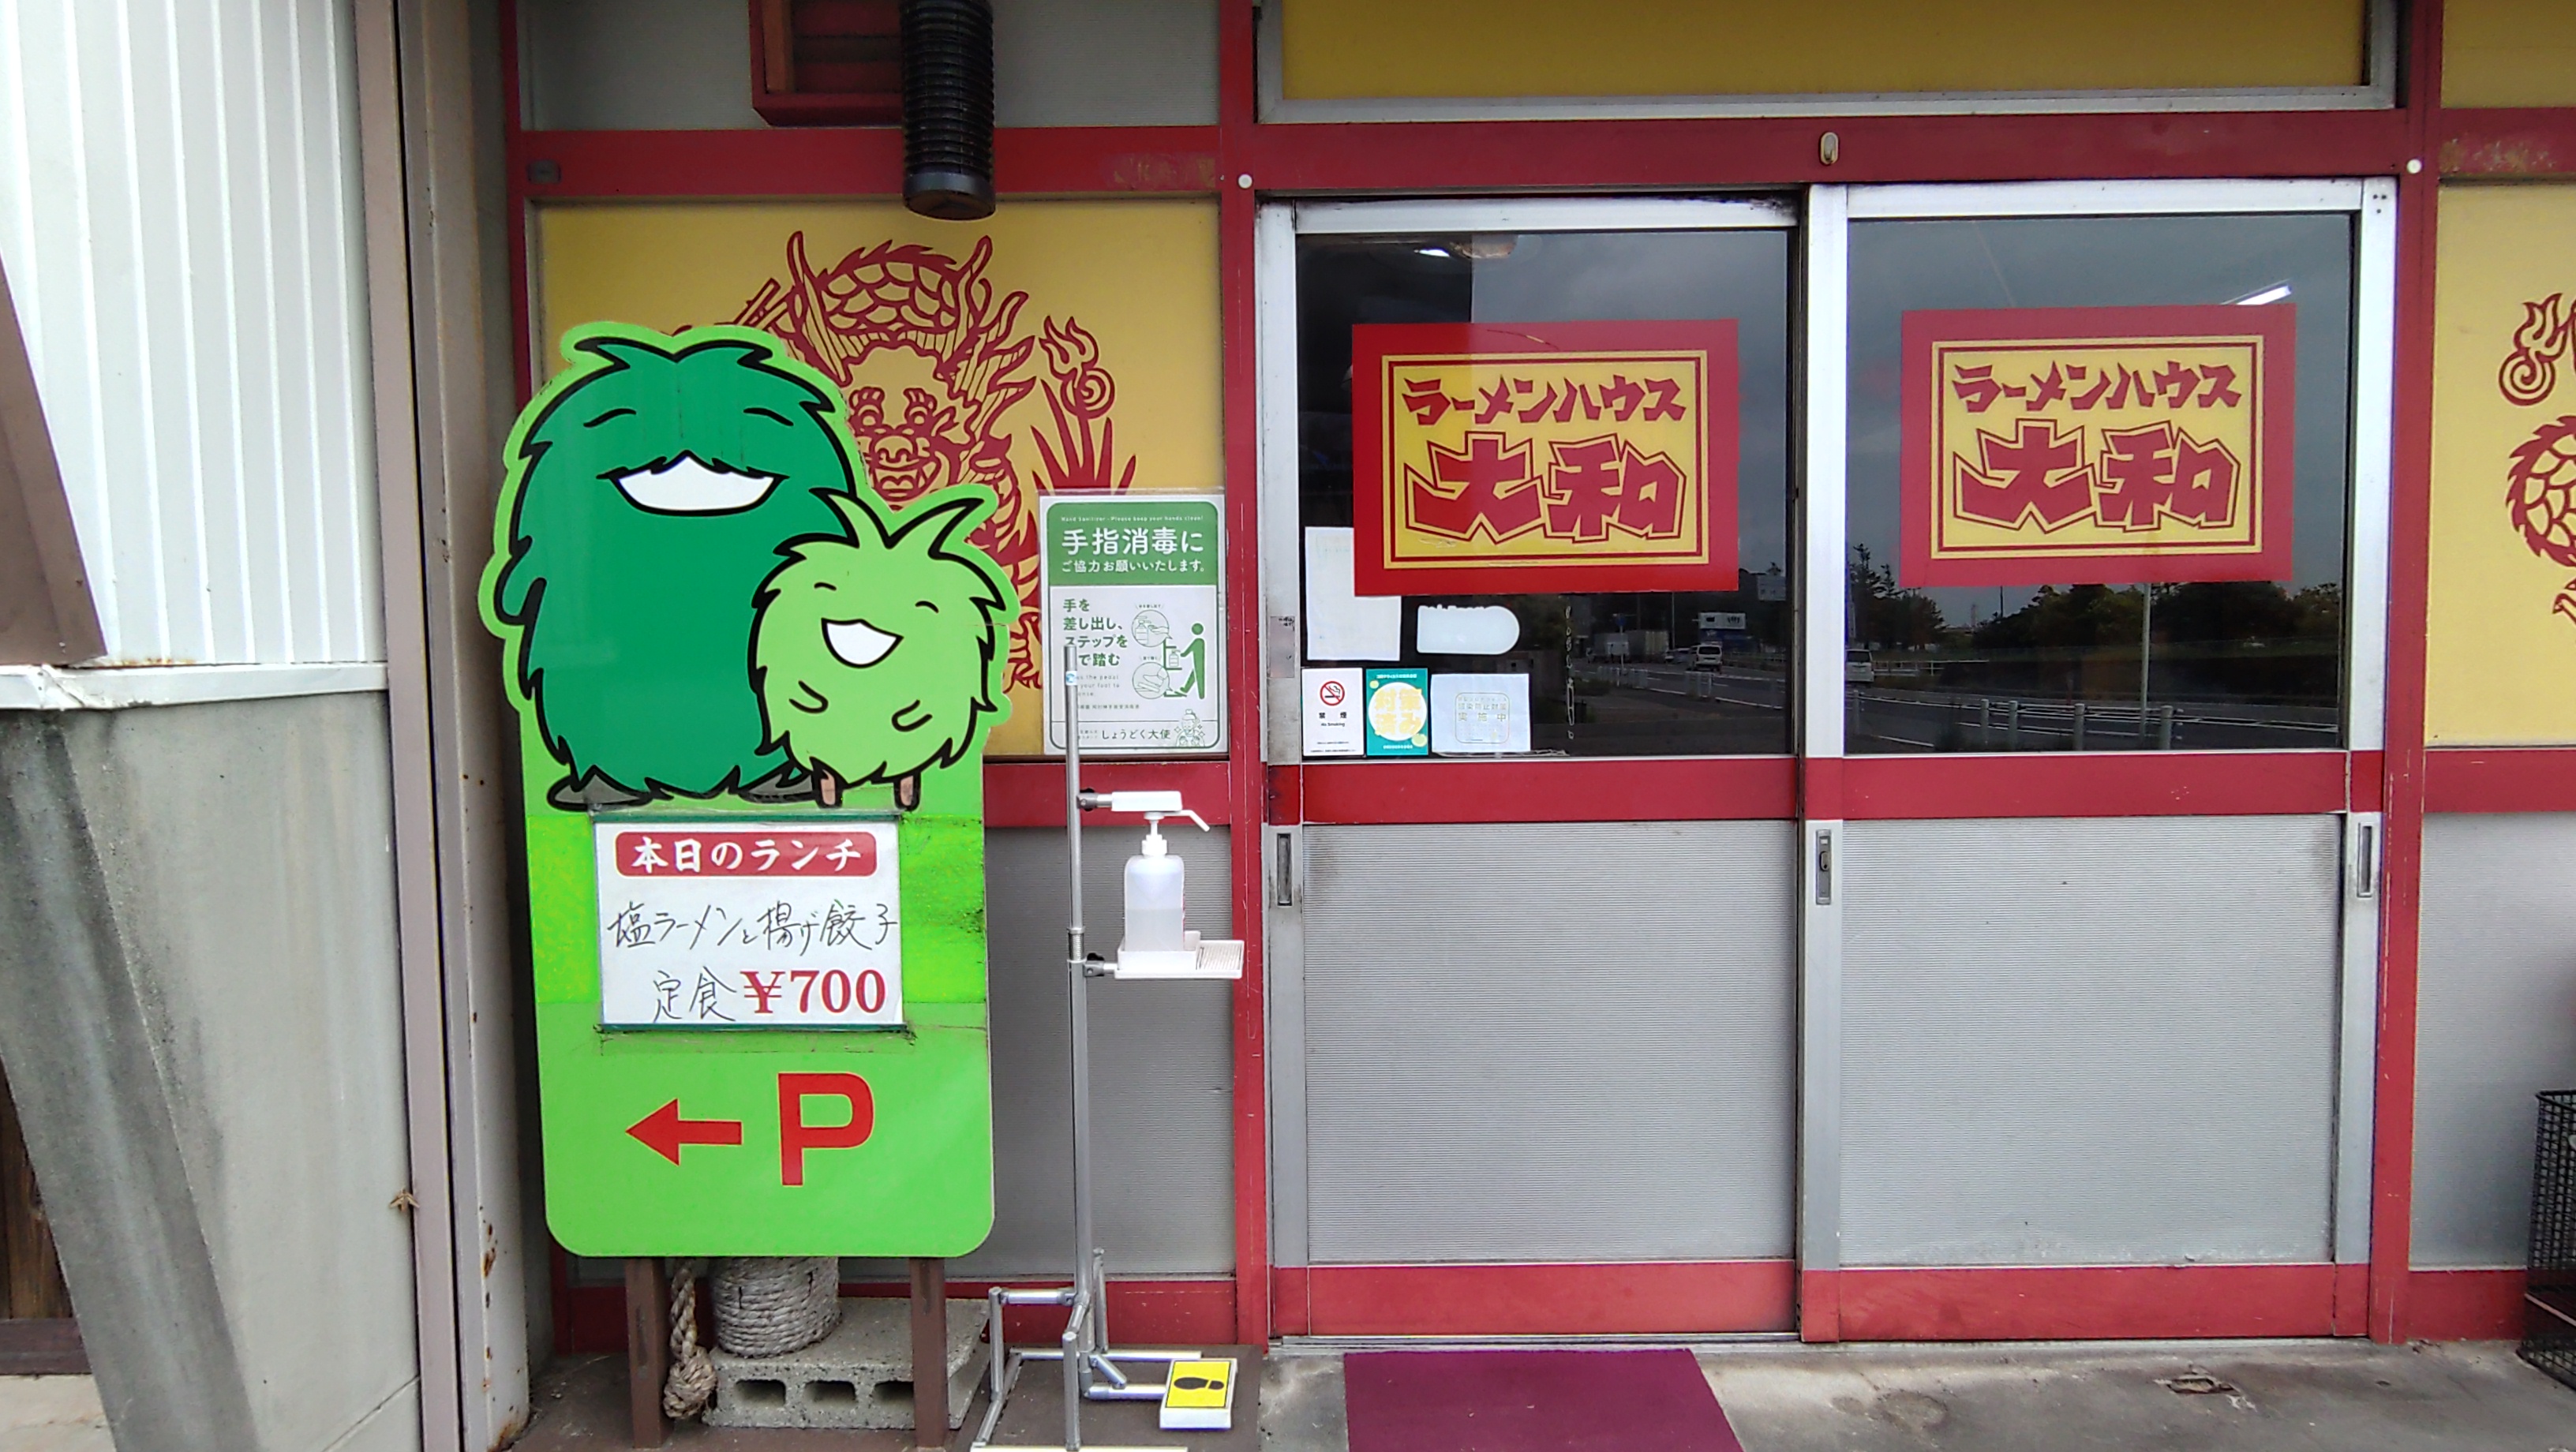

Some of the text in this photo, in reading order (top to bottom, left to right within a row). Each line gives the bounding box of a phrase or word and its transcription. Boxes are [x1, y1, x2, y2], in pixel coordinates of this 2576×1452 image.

[1402, 374, 1687, 425] ラーメンハウス
[1953, 361, 2242, 413] ラーメンハウス
[1404, 430, 1687, 544] 大和
[1953, 418, 2241, 534] 大和
[1061, 526, 1204, 556] 手指消毒に
[1061, 559, 1205, 573] ご協力お願いいたします。
[1063, 598, 1090, 612] 手を
[1063, 616, 1122, 631] 差し出し、
[1065, 634, 1128, 648] ステップを
[1078, 653, 1120, 667] で踏む
[631, 836, 862, 874] 本日のランチ
[607, 900, 899, 956] 塩ラーメンと揚げ餃子
[653, 966, 886, 1023] 定食 ¥700
[777, 1071, 875, 1187] P
